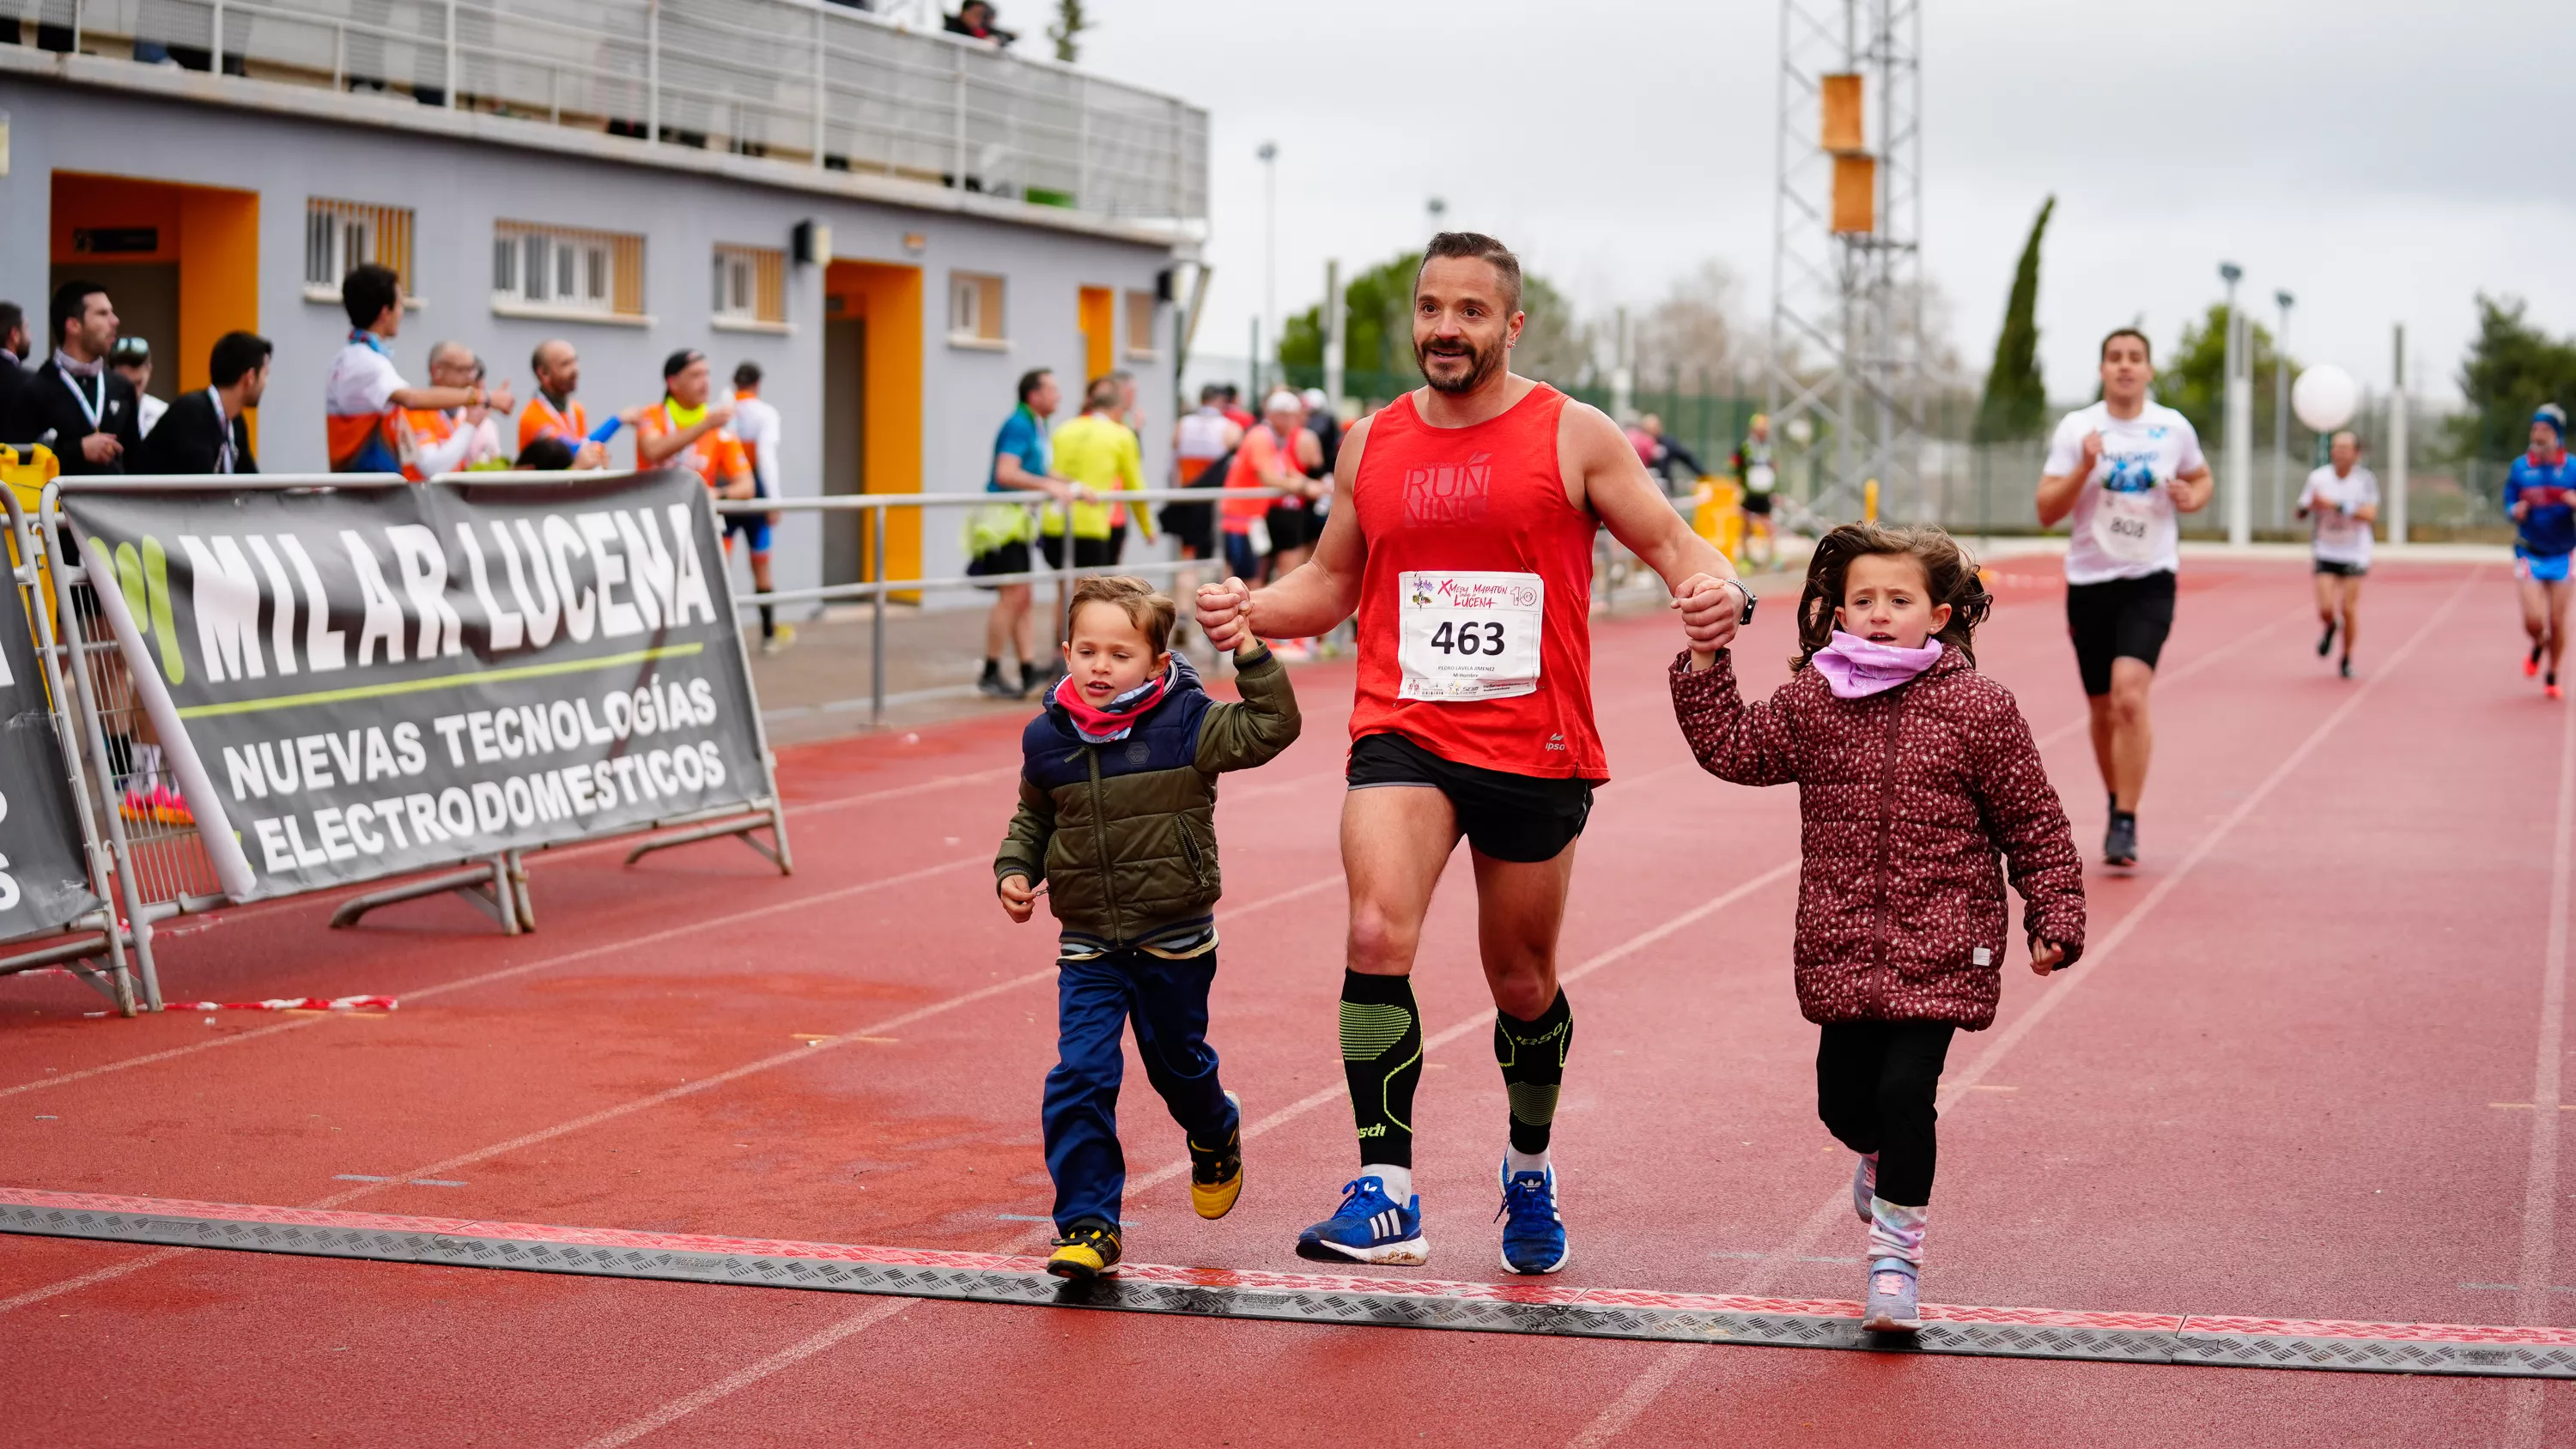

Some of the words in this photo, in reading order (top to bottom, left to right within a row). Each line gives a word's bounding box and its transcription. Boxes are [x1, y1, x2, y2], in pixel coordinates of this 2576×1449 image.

[1406, 464, 1488, 499] RUN
[178, 524, 462, 682] MILAR
[456, 503, 717, 650] LUCENA
[1454, 594, 1498, 609] LUCENA
[1431, 621, 1505, 655] 463
[222, 722, 427, 802] NUEVAS
[434, 673, 717, 767] TECNOLOGÍAS
[253, 740, 726, 874] ELECTRODOMESTICOS
